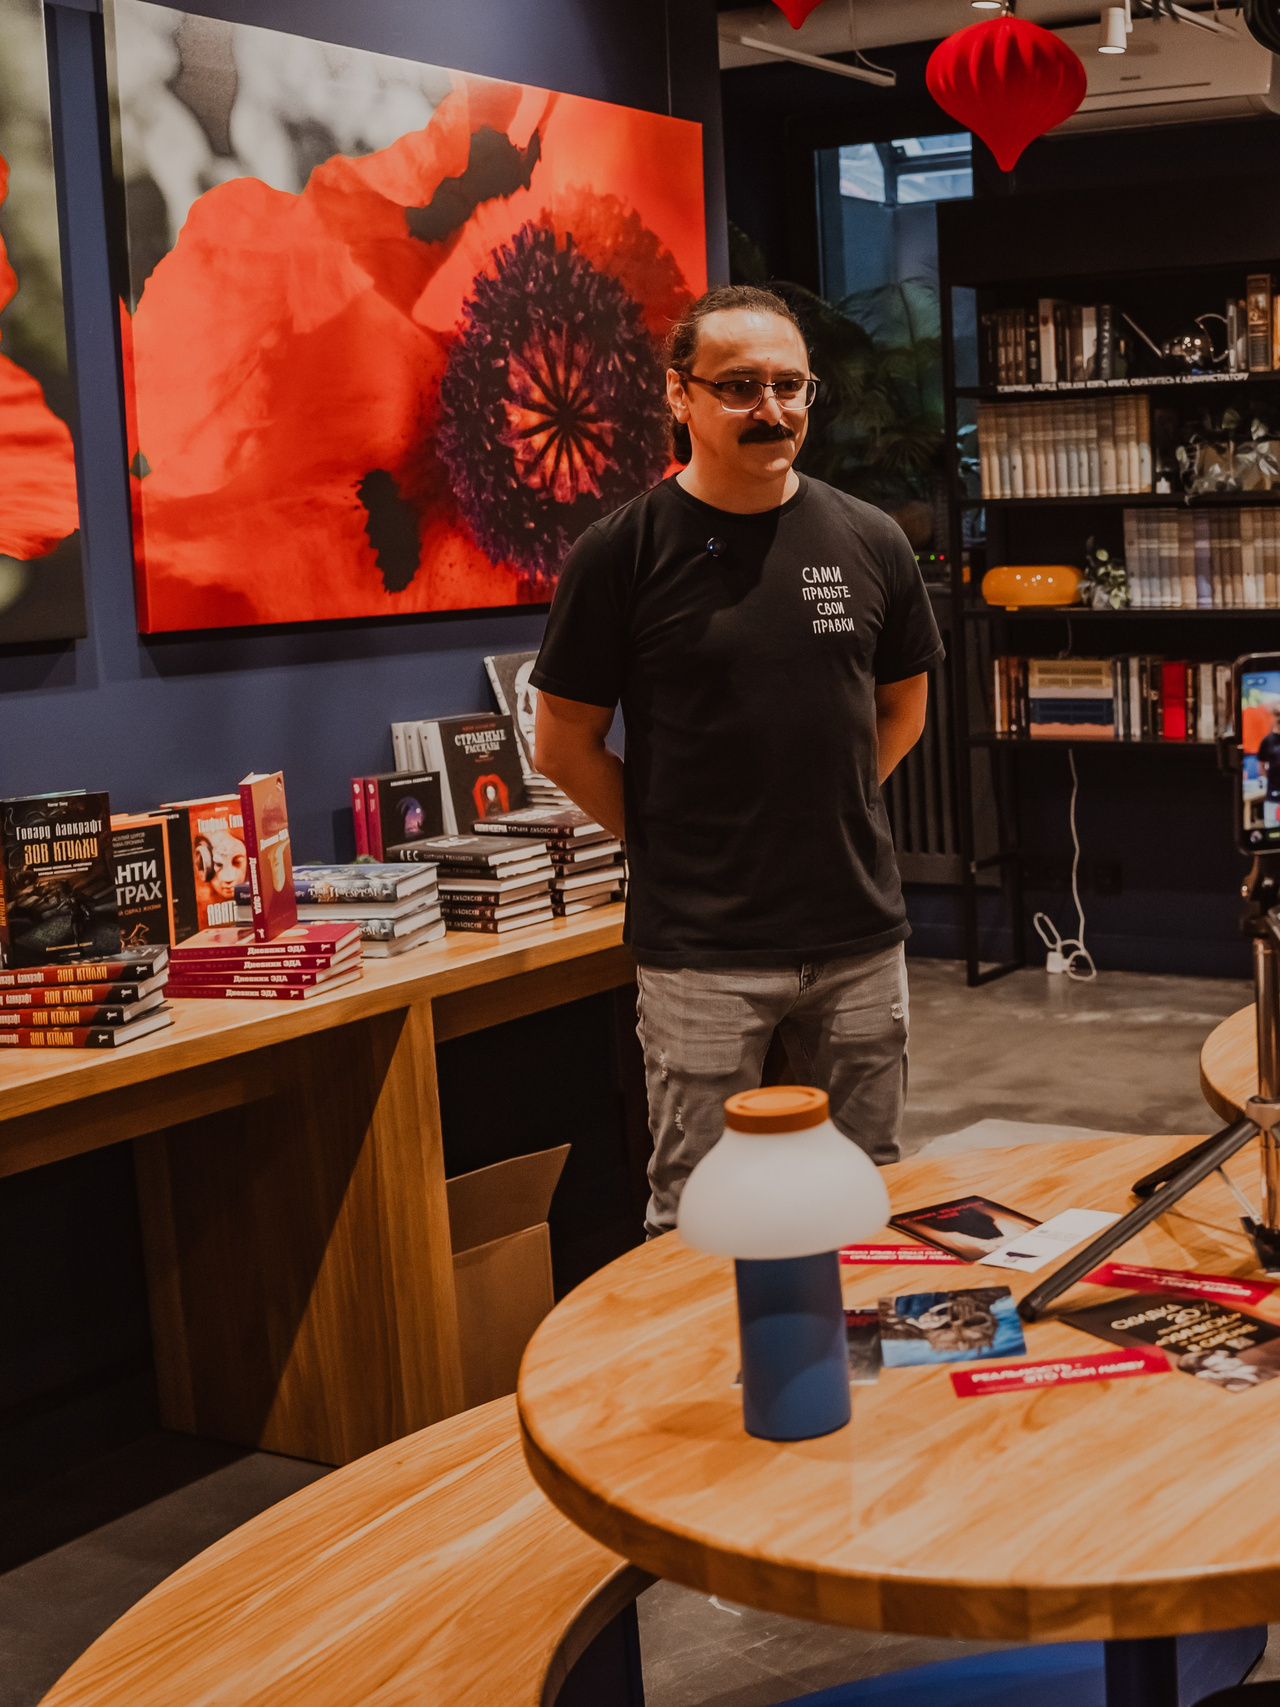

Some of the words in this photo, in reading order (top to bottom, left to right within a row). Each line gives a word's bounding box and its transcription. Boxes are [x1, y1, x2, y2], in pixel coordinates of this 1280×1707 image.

[802, 566, 842, 583] САМИ
[802, 586, 851, 601] ПРАВЬТЕ
[816, 601, 845, 616] СВОИ
[812, 617, 855, 634] ПРАВКИ
[454, 729, 506, 747] СТРАШНЫЕ
[16, 825, 51, 841] Говард
[55, 819, 102, 837] Лавкрафт
[24, 843, 50, 865] ЗОВ
[53, 838, 99, 862] КТУЛХУ
[115, 859, 157, 885] НТИ
[116, 880, 163, 907] ТРАХ
[207, 900, 237, 926] АВАТ
[247, 946, 286, 956] Дневник
[287, 945, 306, 954] ЭДА
[244, 960, 282, 970] Дневник
[283, 959, 302, 968] ЭДА
[57, 969, 74, 983] ЗОВ
[76, 966, 107, 981] КТУЛХУ
[233, 975, 270, 984] Дневник
[271, 975, 288, 983] ЭДА
[44, 991, 61, 1004] ЗОВ
[63, 988, 93, 1004] КТУЛХУ
[226, 989, 260, 998] Дневник
[261, 990, 278, 998] ЭДА
[32, 1011, 48, 1025] ЗОВ
[51, 1010, 80, 1024] КТУЛХУ
[30, 1032, 45, 1045] ЗОВ
[47, 1031, 74, 1045] КТУЛХУ
